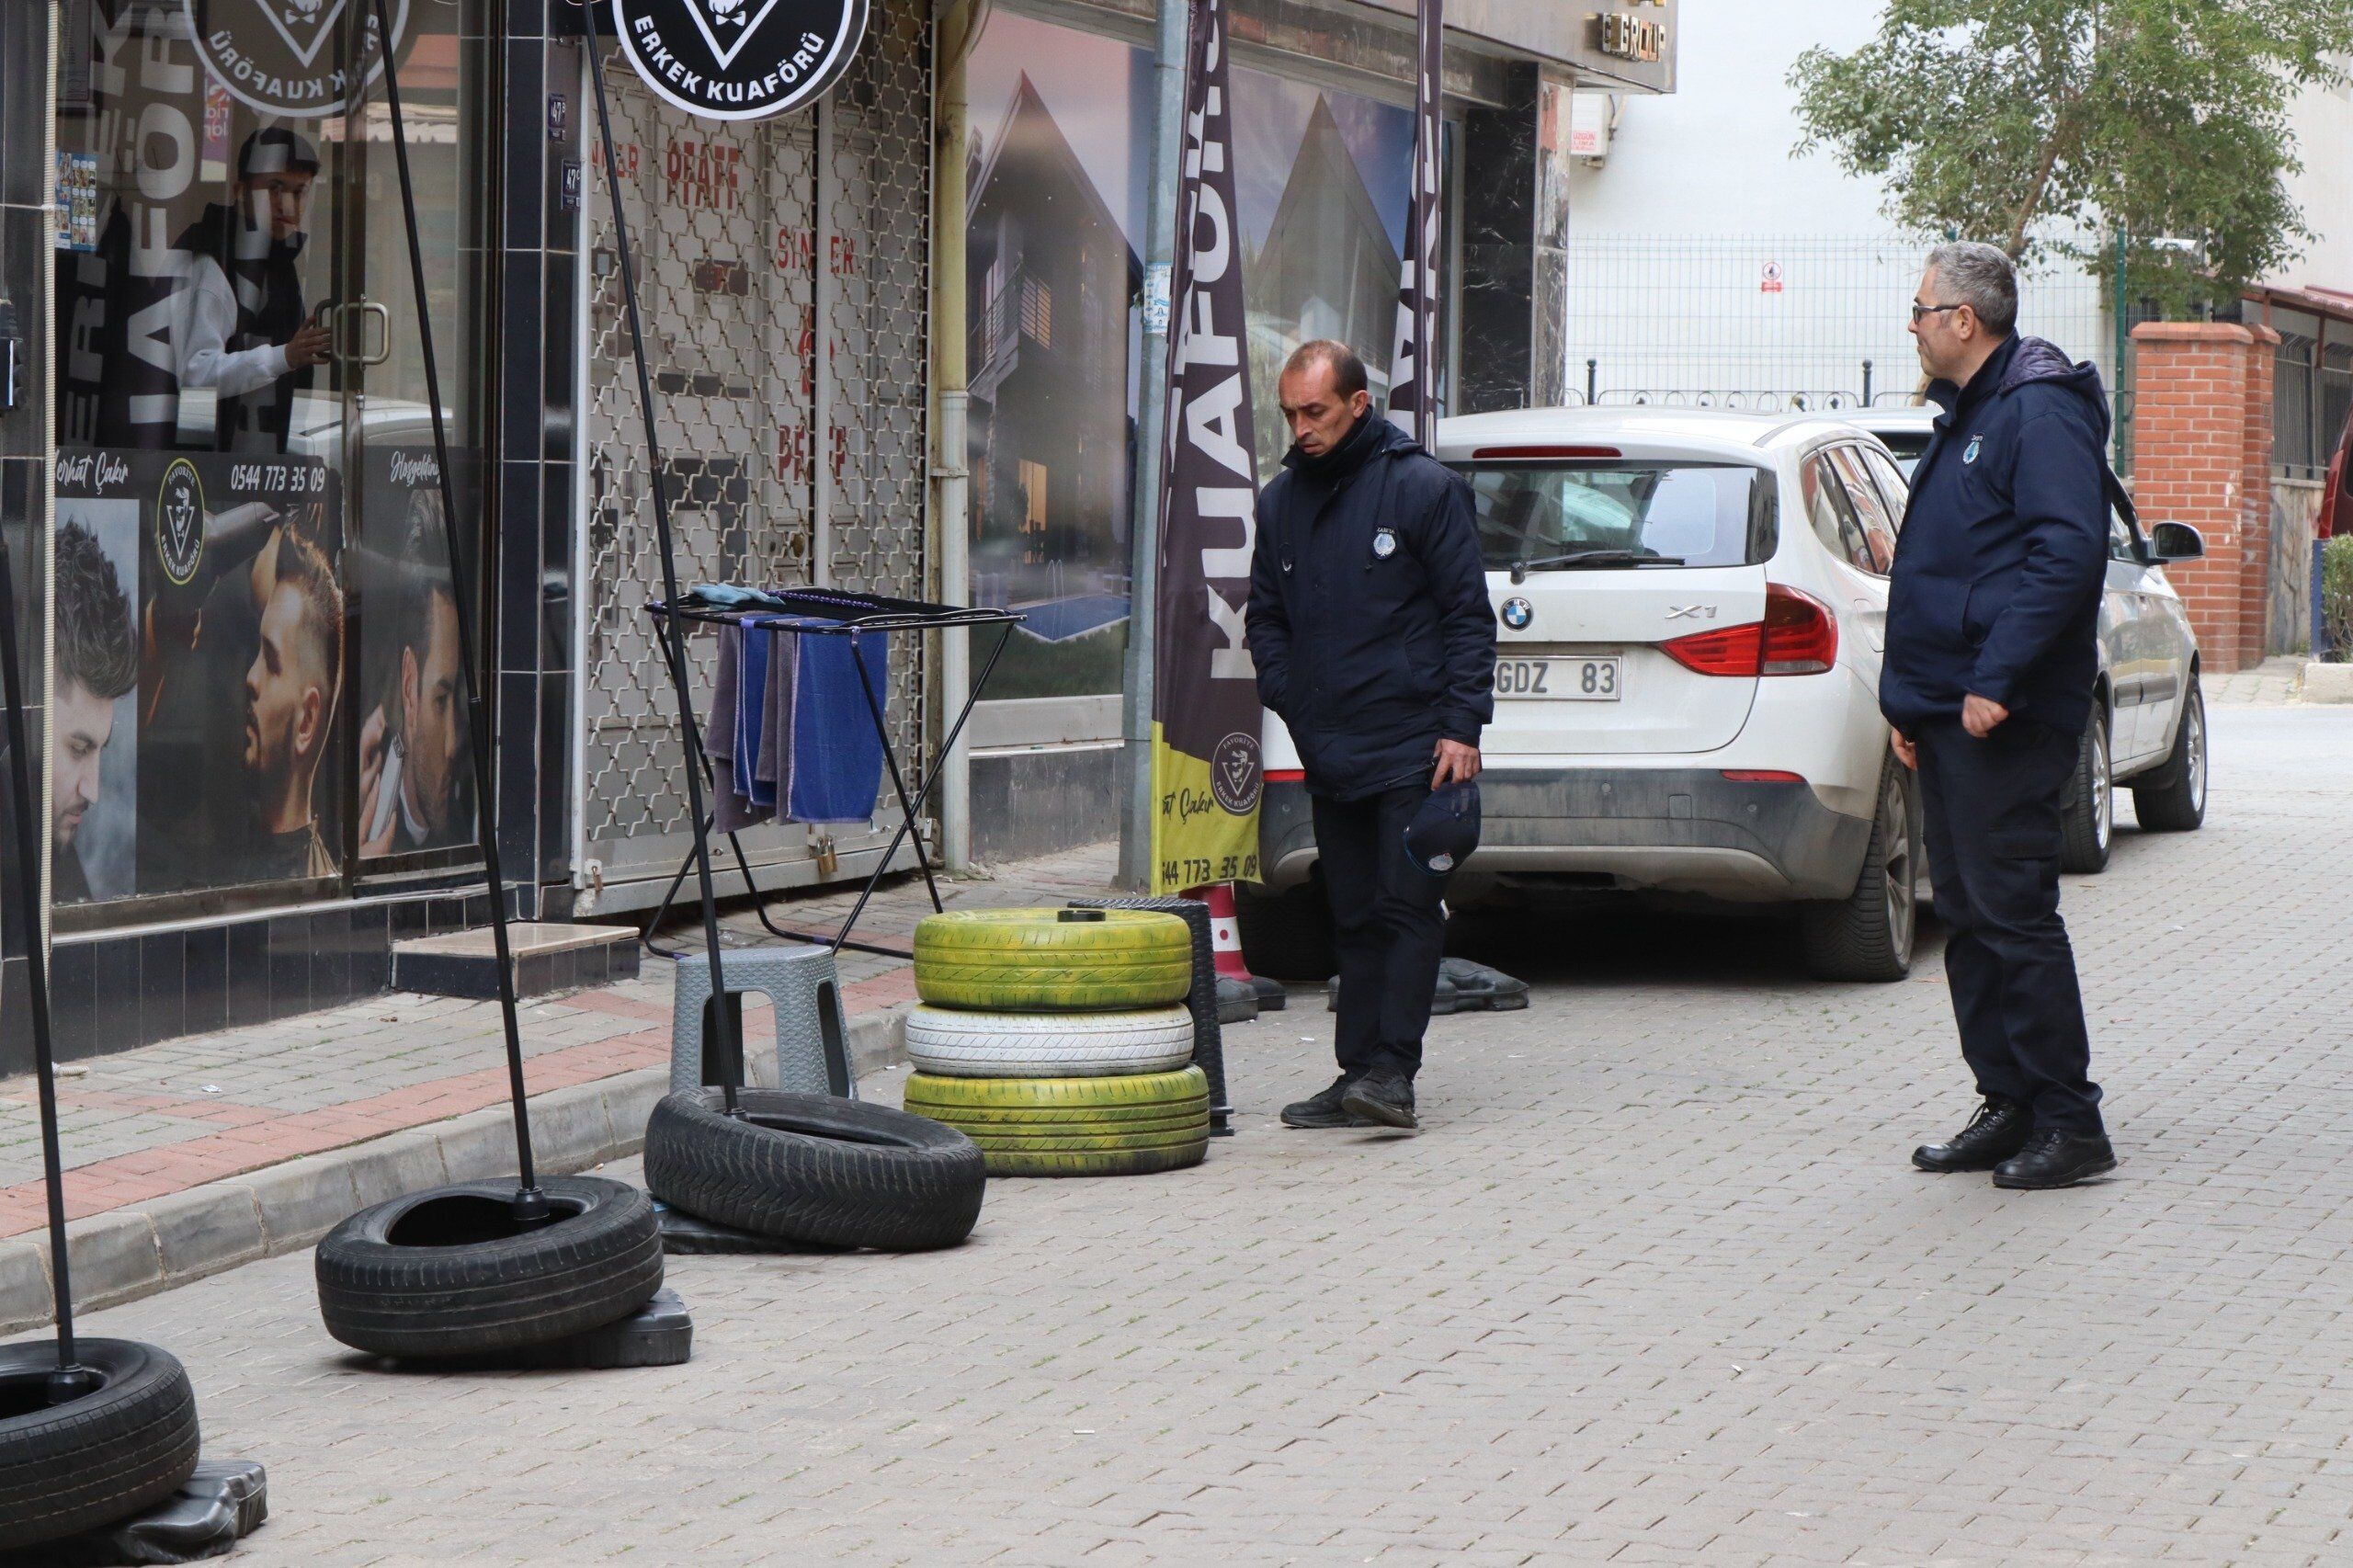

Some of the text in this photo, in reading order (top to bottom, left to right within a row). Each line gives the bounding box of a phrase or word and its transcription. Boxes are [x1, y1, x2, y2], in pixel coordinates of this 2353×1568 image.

[634, 15, 825, 102] ERKEK KUAFÖRÜ
[666, 140, 740, 210] PFAFF
[778, 230, 854, 274] SINER
[55, 449, 94, 488] erhat
[231, 464, 324, 492] 0544 773 35 09
[1665, 604, 1717, 619] X1
[1496, 662, 1615, 694] GDZ 83
[1184, 858, 1211, 883] 773
[1219, 856, 1238, 879] 35
[1244, 854, 1257, 878] 09
